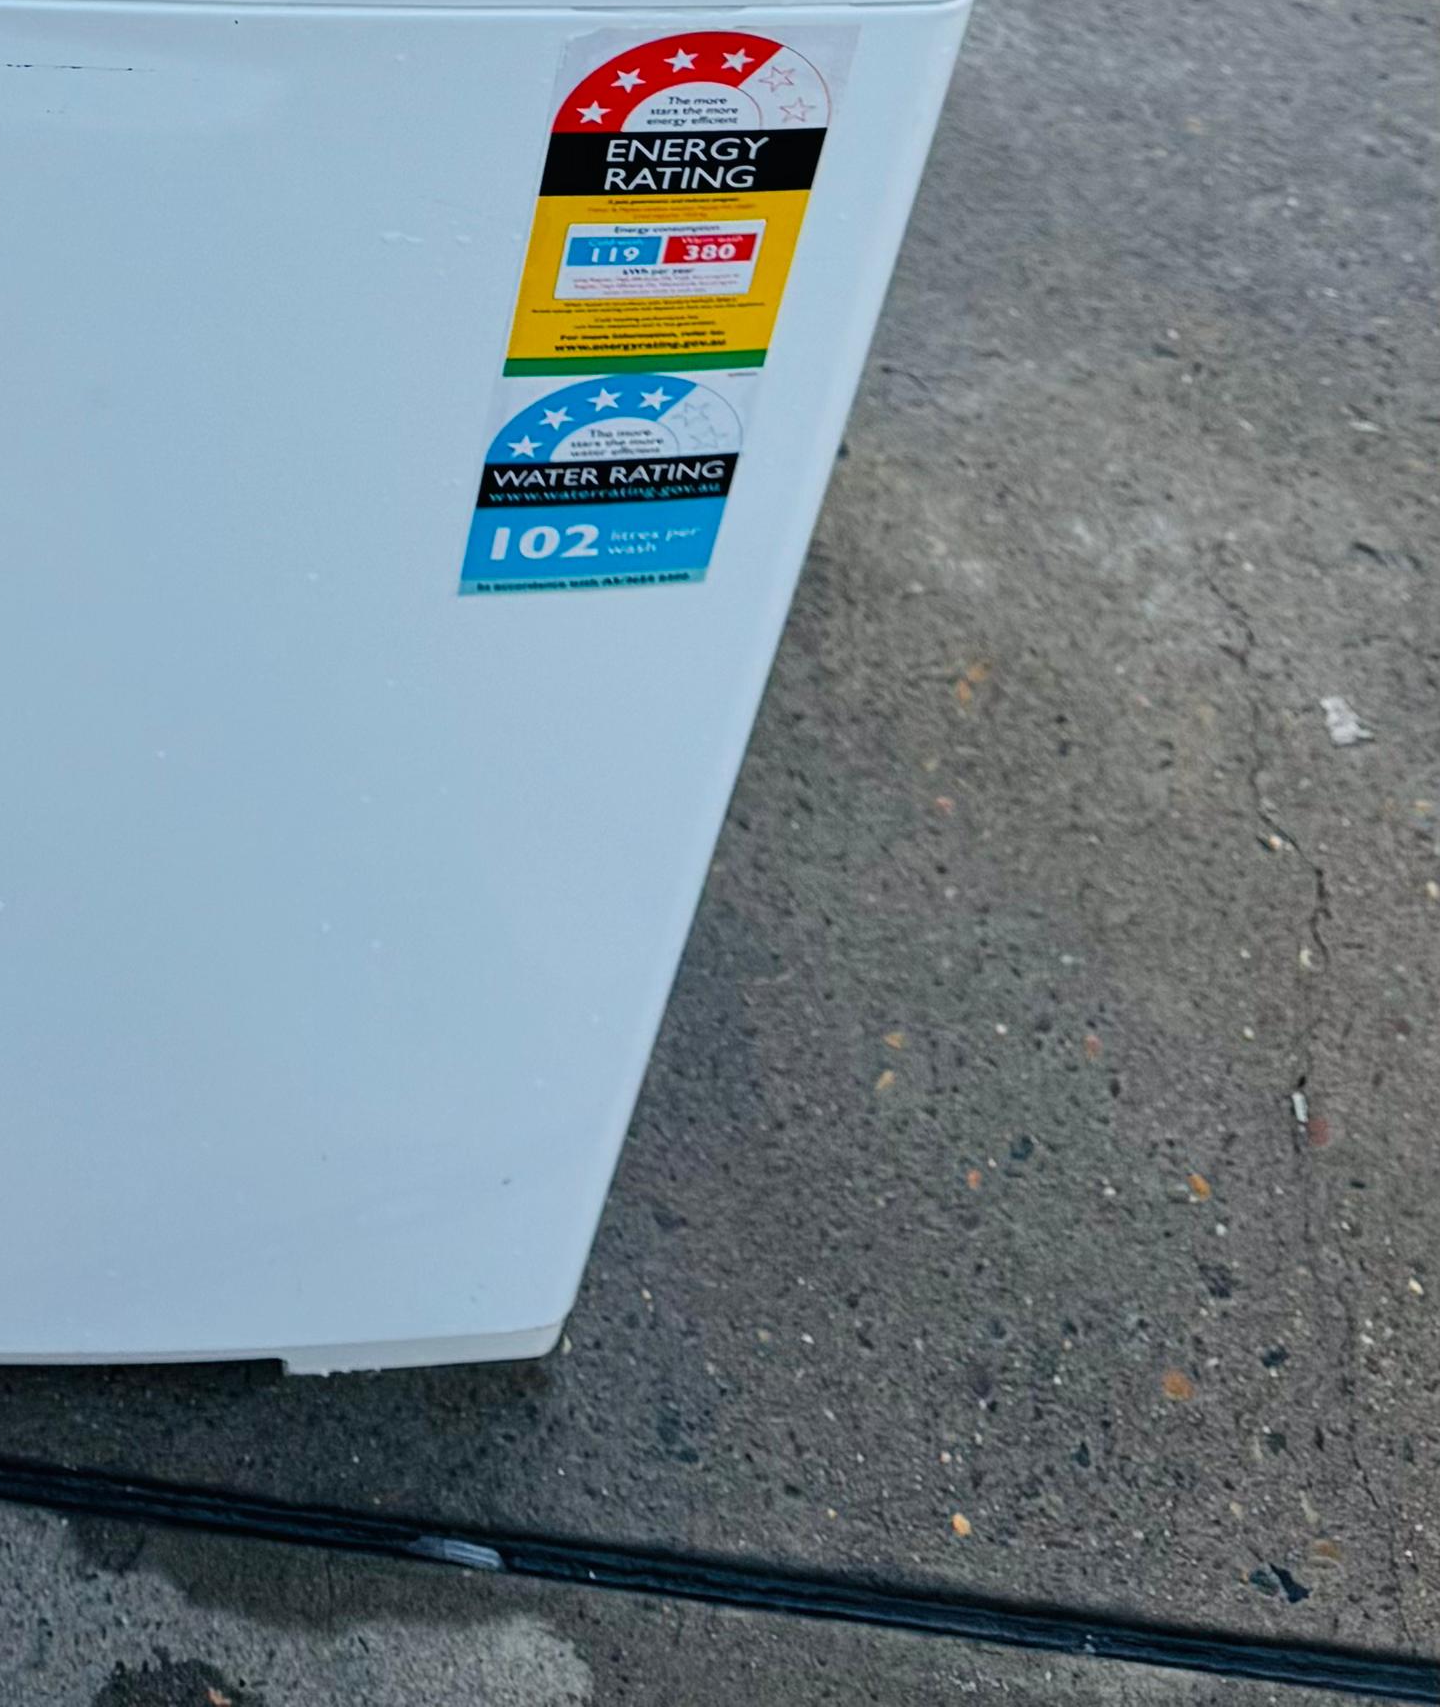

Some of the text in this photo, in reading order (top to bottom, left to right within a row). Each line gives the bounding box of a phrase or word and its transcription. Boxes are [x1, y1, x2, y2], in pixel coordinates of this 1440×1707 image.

[668, 96, 690, 105] The
[646, 116, 738, 126] energy efficient
[606, 137, 770, 162] ENERGY
[604, 165, 756, 190] RATING
[614, 226, 650, 235] Energy
[591, 246, 640, 263] 119
[683, 244, 737, 261] 380
[493, 460, 726, 488] WATER RATING
[489, 483, 721, 502] www.waterrating.gov.au
[490, 524, 600, 561] 102
[607, 542, 657, 555] wash
